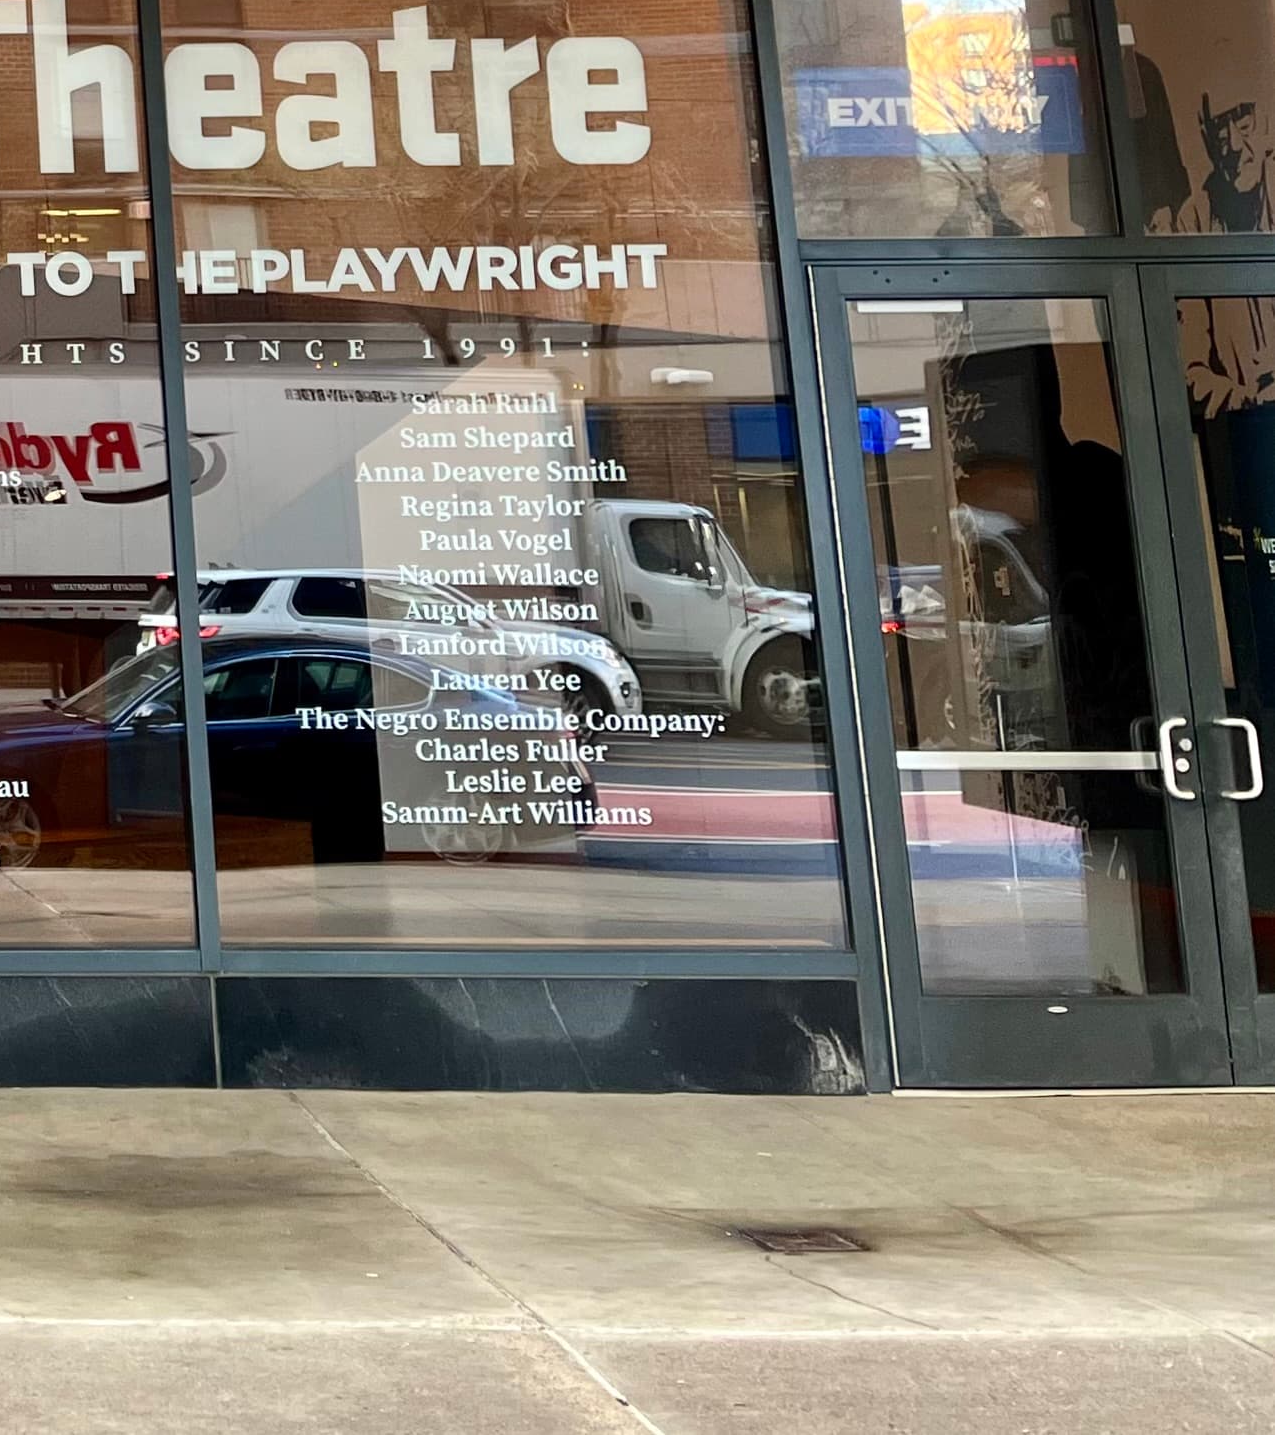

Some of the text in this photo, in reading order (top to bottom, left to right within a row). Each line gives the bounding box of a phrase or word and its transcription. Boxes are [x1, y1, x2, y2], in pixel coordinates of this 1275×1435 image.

[8, 251, 93, 298] TO
[251, 243, 668, 294] PLAYWRIGHT
[184, 339, 366, 362] SINCE
[412, 393, 488, 415] Sarah
[495, 392, 557, 415] Ruhl
[400, 426, 575, 454] Sam Shepard
[355, 459, 627, 483] Anna Deavere Smith
[401, 495, 585, 523] Regina Taylor
[420, 528, 572, 556] Paula Vogel
[398, 563, 599, 586] Naomi Wallace
[403, 597, 598, 627] August Wilson
[400, 633, 606, 657] Lanford Wilson
[432, 670, 581, 692] Lauren Yee
[296, 707, 726, 738] The Negro Ensemble Company:
[415, 738, 608, 763] Charles Fuller
[446, 770, 582, 794] Leslie Lee
[382, 801, 652, 827] Samm-Art Williams
